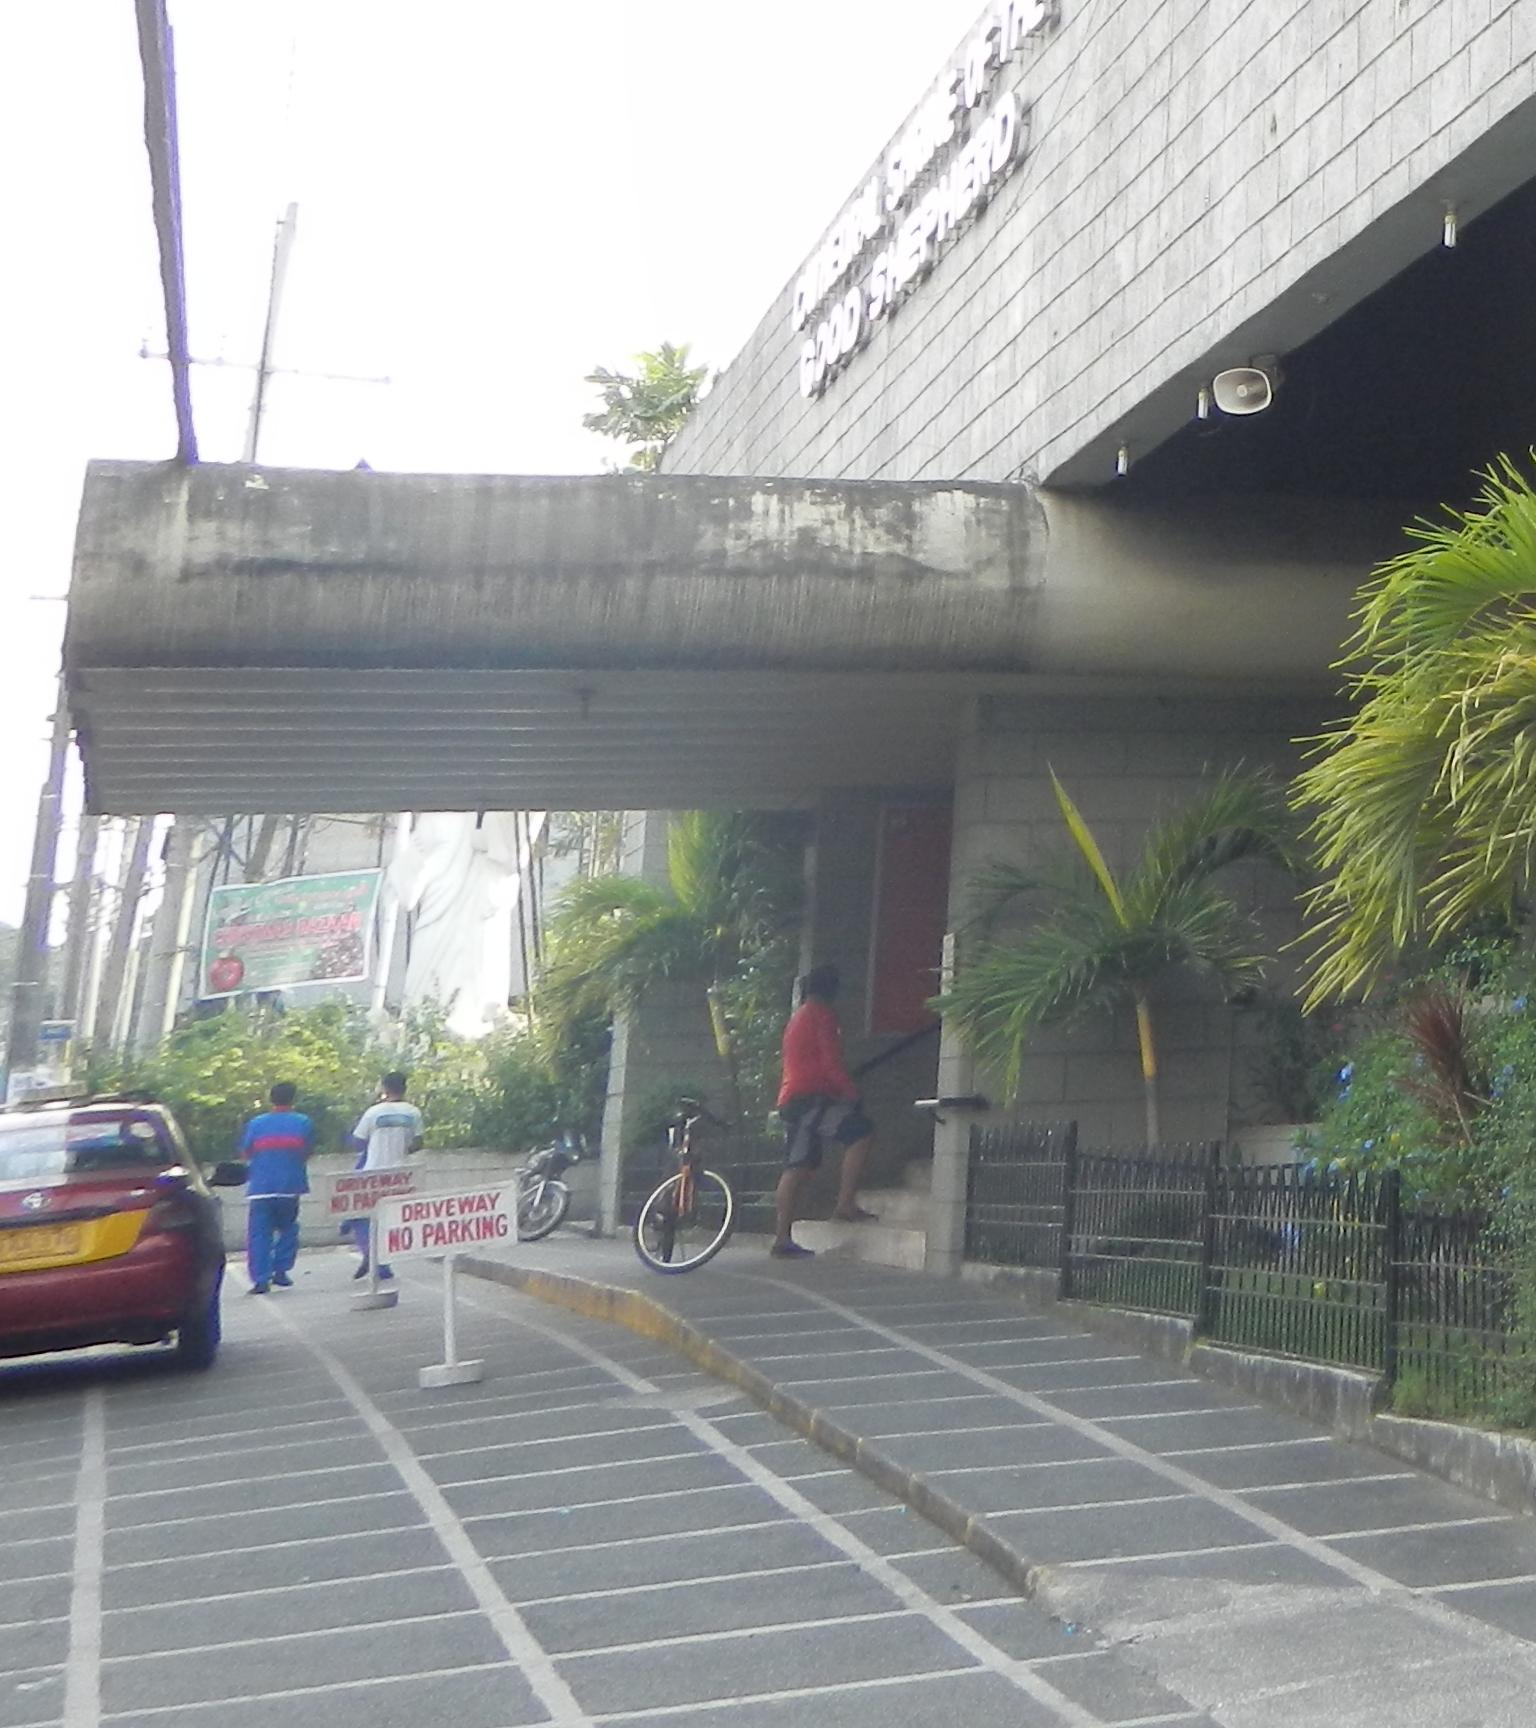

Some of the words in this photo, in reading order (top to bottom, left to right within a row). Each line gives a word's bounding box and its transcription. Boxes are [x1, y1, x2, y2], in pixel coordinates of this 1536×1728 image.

[963, 17, 997, 108] OF
[799, 286, 862, 398] GOOD
[868, 91, 1016, 320] SHEPHERD
[335, 1172, 413, 1193] DRIVEWAY
[331, 1194, 350, 1213] NO
[401, 1192, 500, 1222] DRIVEWAY
[388, 1226, 413, 1252] NO
[422, 1214, 508, 1247] PARKING
